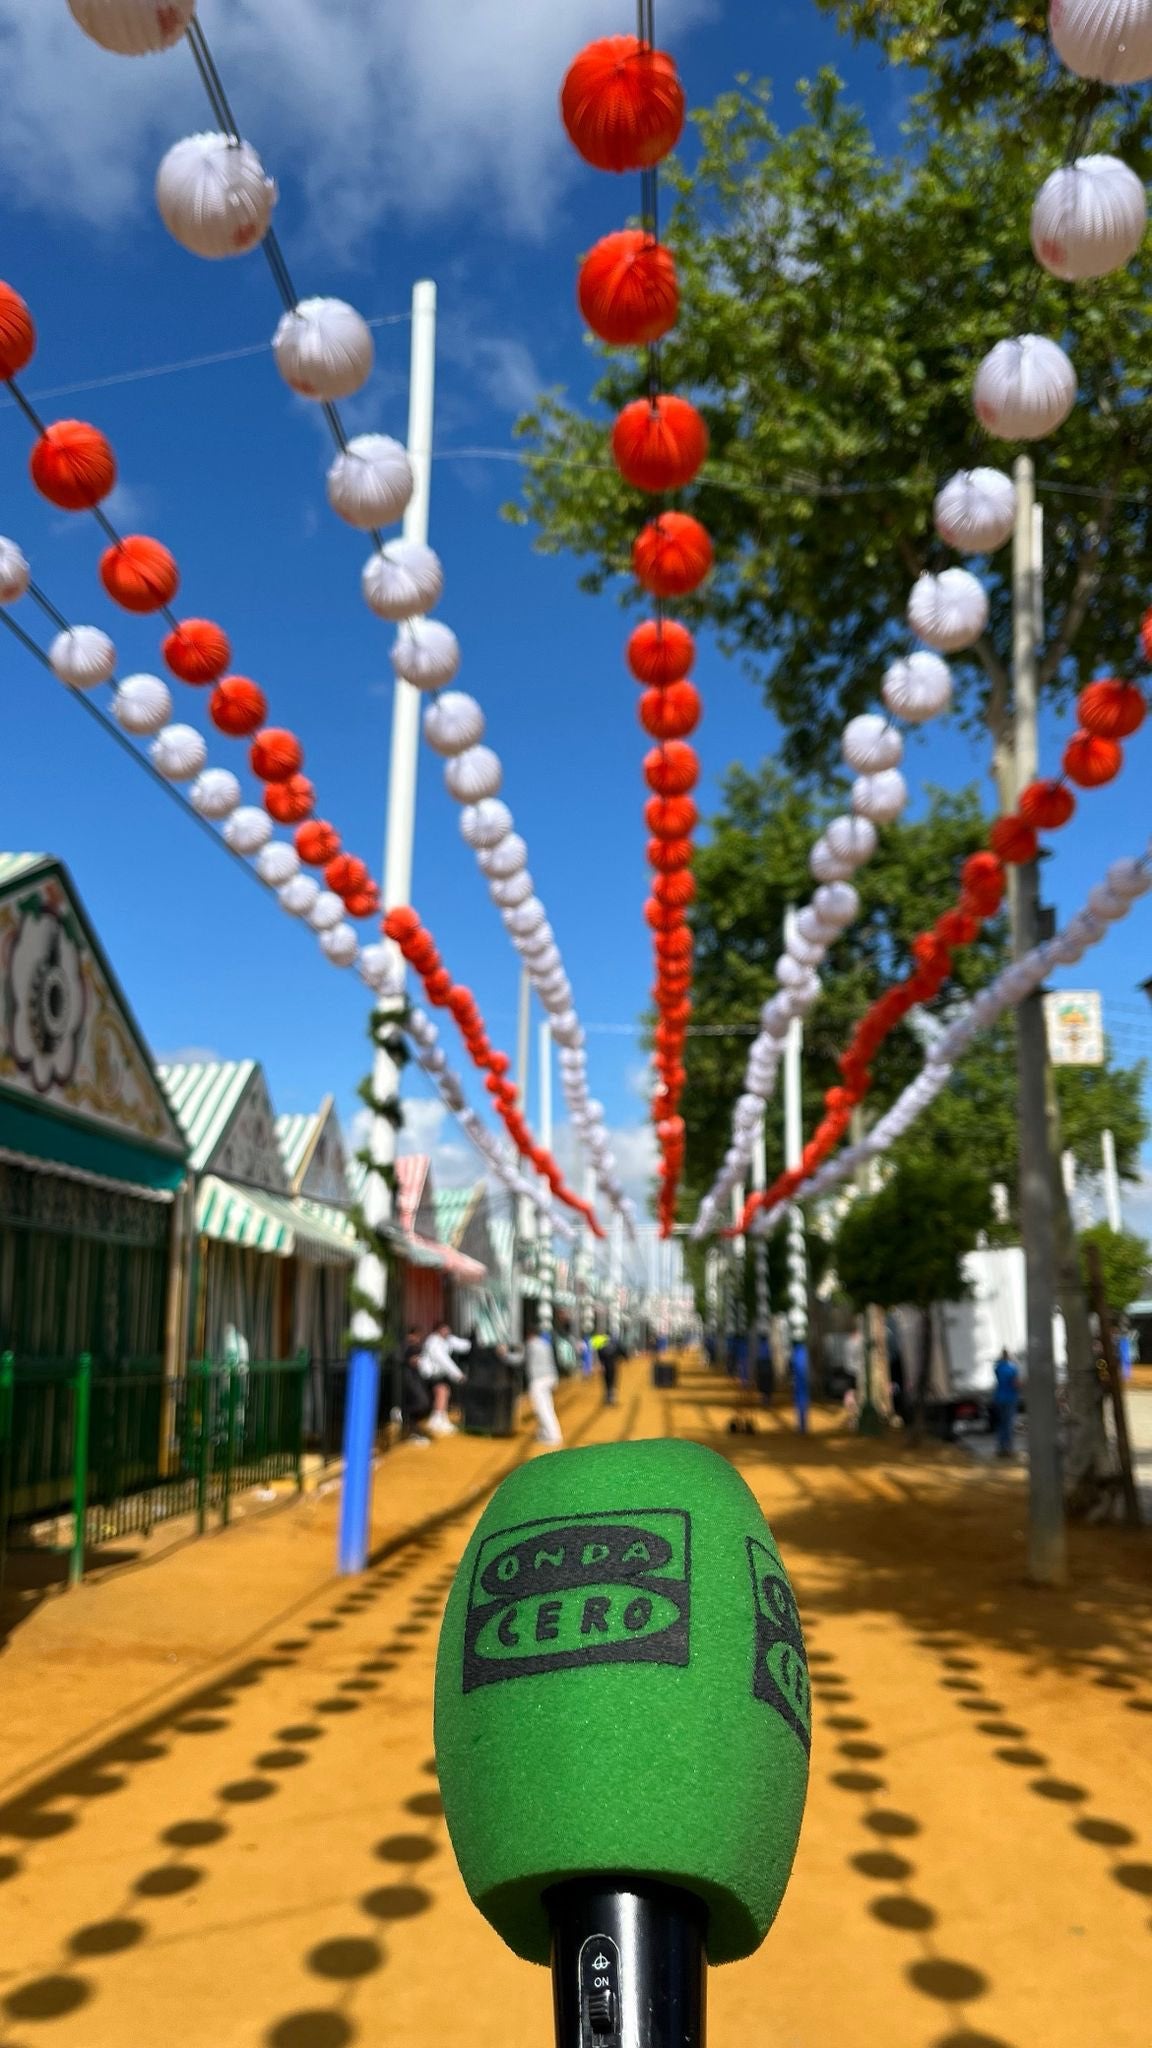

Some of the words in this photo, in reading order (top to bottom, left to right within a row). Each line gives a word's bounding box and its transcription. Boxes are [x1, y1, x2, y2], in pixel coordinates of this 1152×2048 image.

[497, 1541, 651, 1580] ONDA
[498, 1597, 654, 1647] CERO
[594, 1977, 610, 1988] ON
